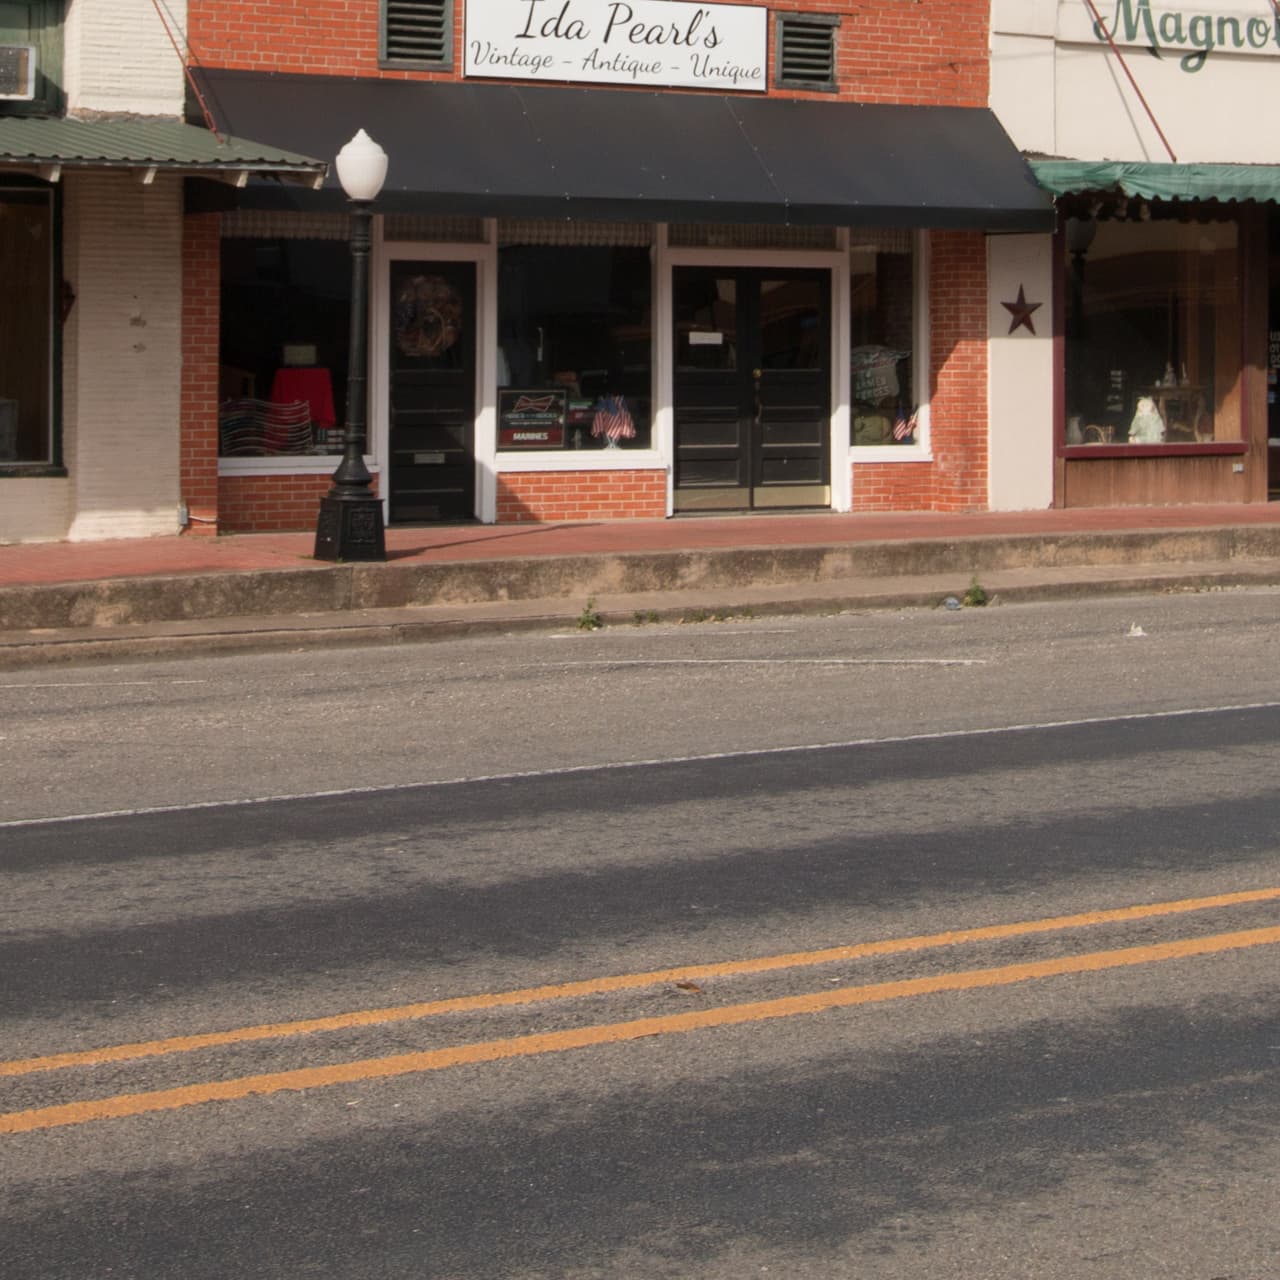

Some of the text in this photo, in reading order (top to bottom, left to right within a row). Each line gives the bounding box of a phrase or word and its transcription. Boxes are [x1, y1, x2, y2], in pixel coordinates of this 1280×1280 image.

[603, 2, 723, 48] Pearl's
[470, 40, 553, 74] Vintage
[582, 48, 662, 79] Antique
[690, 53, 761, 84] Unique
